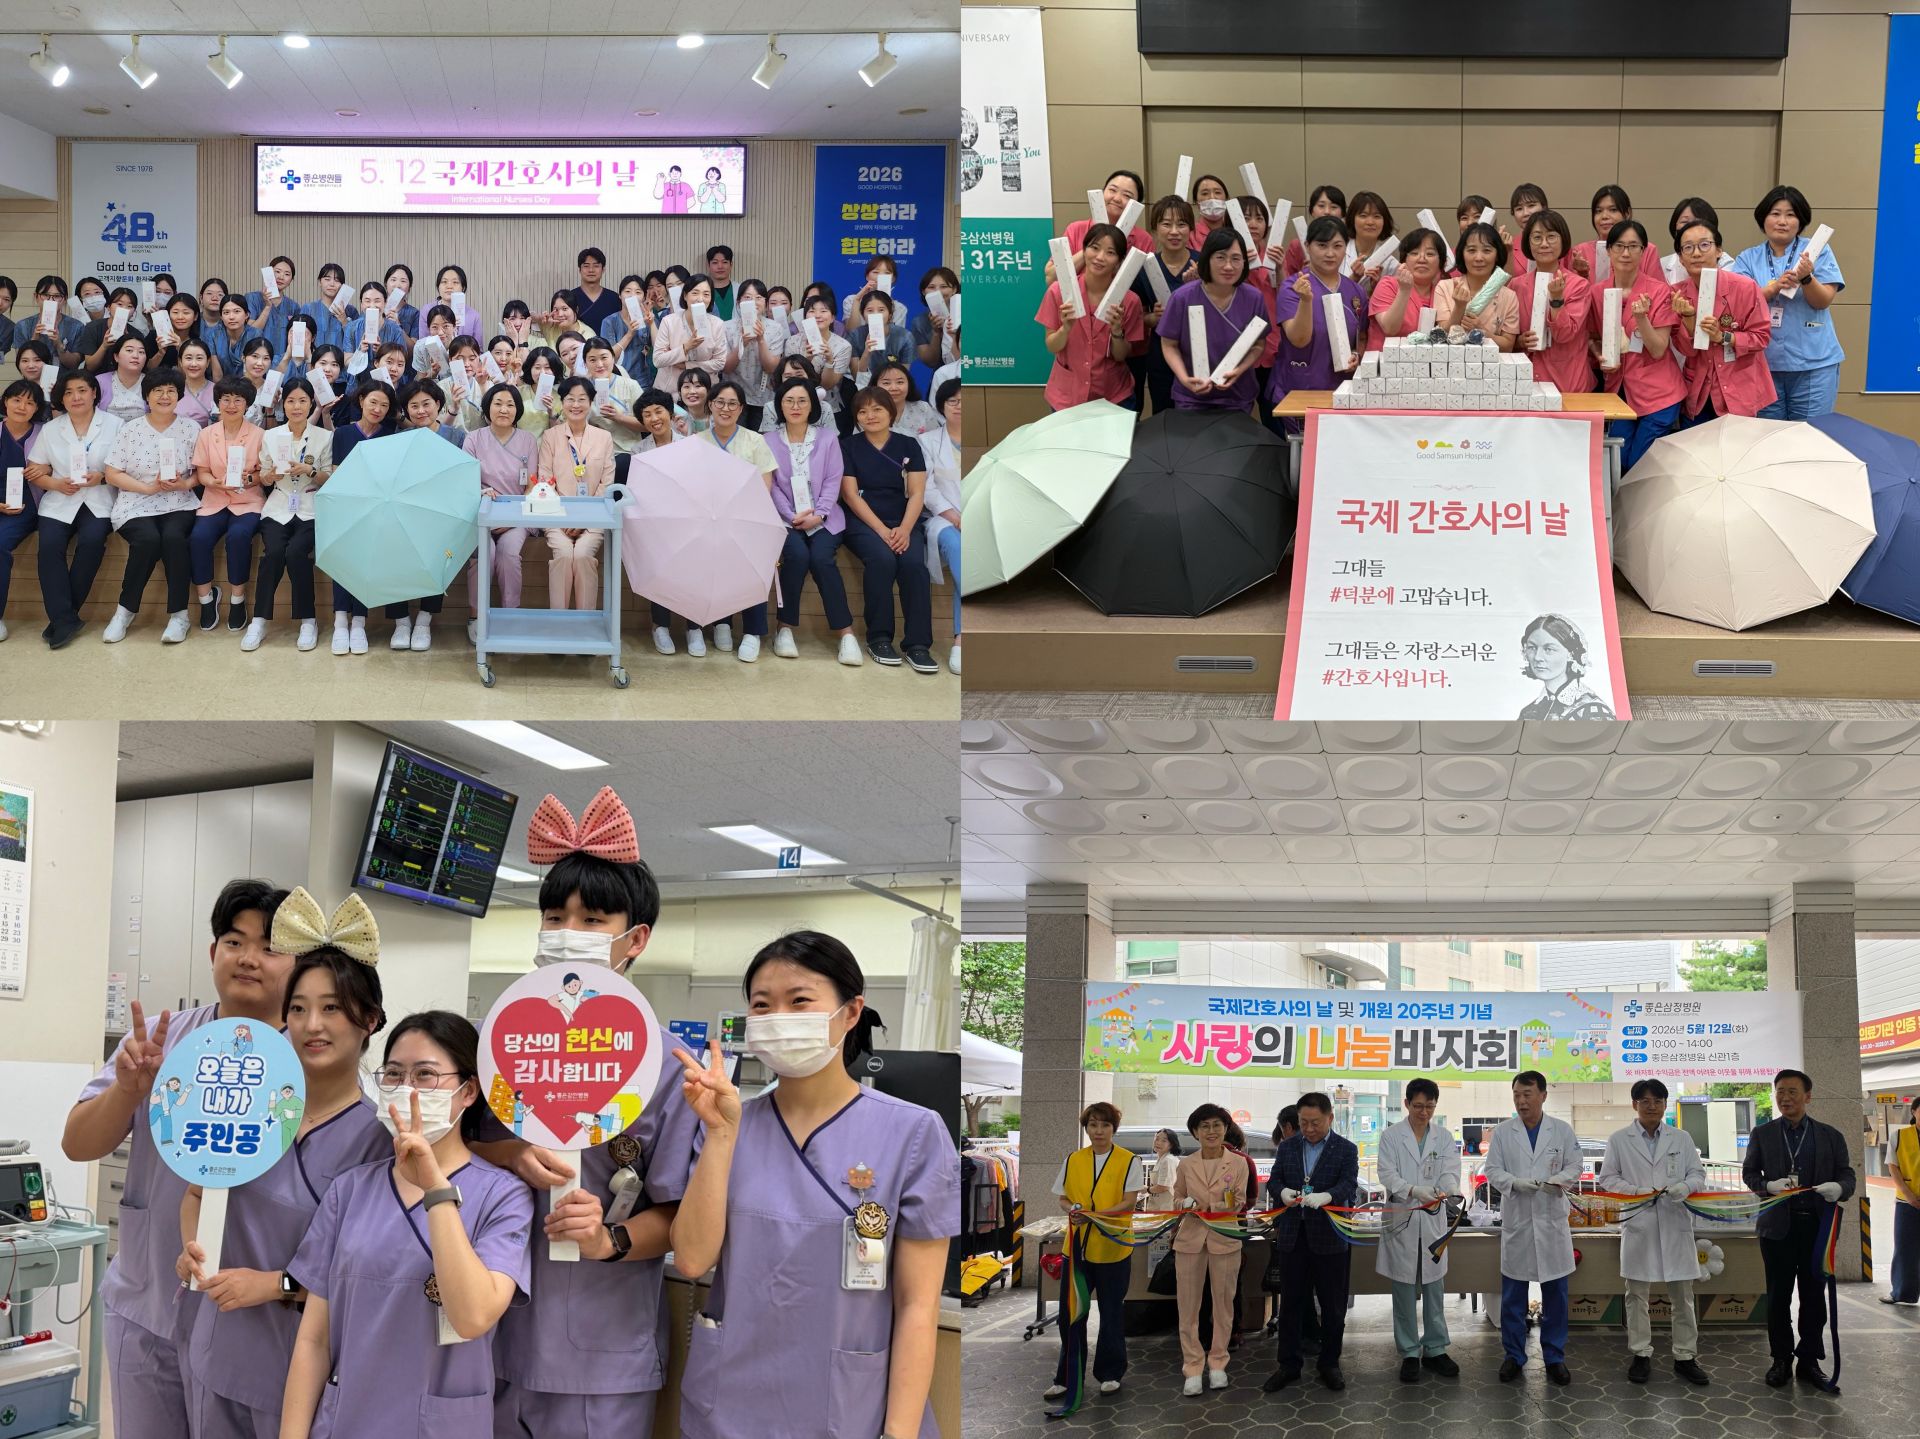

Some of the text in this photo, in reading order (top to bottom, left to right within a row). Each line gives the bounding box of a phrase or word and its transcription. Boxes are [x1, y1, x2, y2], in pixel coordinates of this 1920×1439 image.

[1000, 151, 1020, 162] Love
[1023, 147, 1041, 159] You
[303, 173, 342, 184] 좋은병원들
[360, 158, 640, 187] 5. 12 국제간호사의 날
[858, 166, 902, 182] 2026
[841, 203, 917, 220] 상상하라
[841, 237, 916, 255] 협력하라
[97, 261, 171, 272] Good to Great
[971, 250, 1032, 270] 31주년
[1416, 452, 1493, 461] Good Samsun Hospital
[1337, 499, 1570, 537] 국제 간호사의 날
[1332, 559, 1386, 578] 그대들
[1330, 586, 1493, 607] #덕분에 고맙습니다.
[1324, 641, 1497, 662] 그대들은 자랑스러운
[1321, 668, 1452, 689] #간호사입니다.
[781, 848, 799, 867] 14
[1208, 997, 1492, 1021] 국제간호사의 날 및 개원 20주년 기념
[1645, 1001, 1701, 1013] 좋은삼정병원
[1627, 1023, 1748, 1036] 날짜 2026년 5월 12일(화)
[1860, 1021, 1895, 1041] 의료기관
[1896, 1016, 1916, 1035] 인증
[504, 1027, 633, 1054] 당신의 헌신에
[1162, 1022, 1296, 1069] 사랑의
[1627, 1039, 1643, 1049] 시간
[1651, 1039, 1677, 1048] 10:00
[1686, 1038, 1713, 1048] 14:00
[1627, 1052, 1740, 1063] 장소 좋은삼정병원 신관1층
[196, 1055, 264, 1086] 오늘은
[514, 1059, 622, 1084] 감사합니다
[1655, 1068, 1681, 1077] 수익금은
[202, 1086, 252, 1115] 내가
[182, 1121, 262, 1155] 주인공
